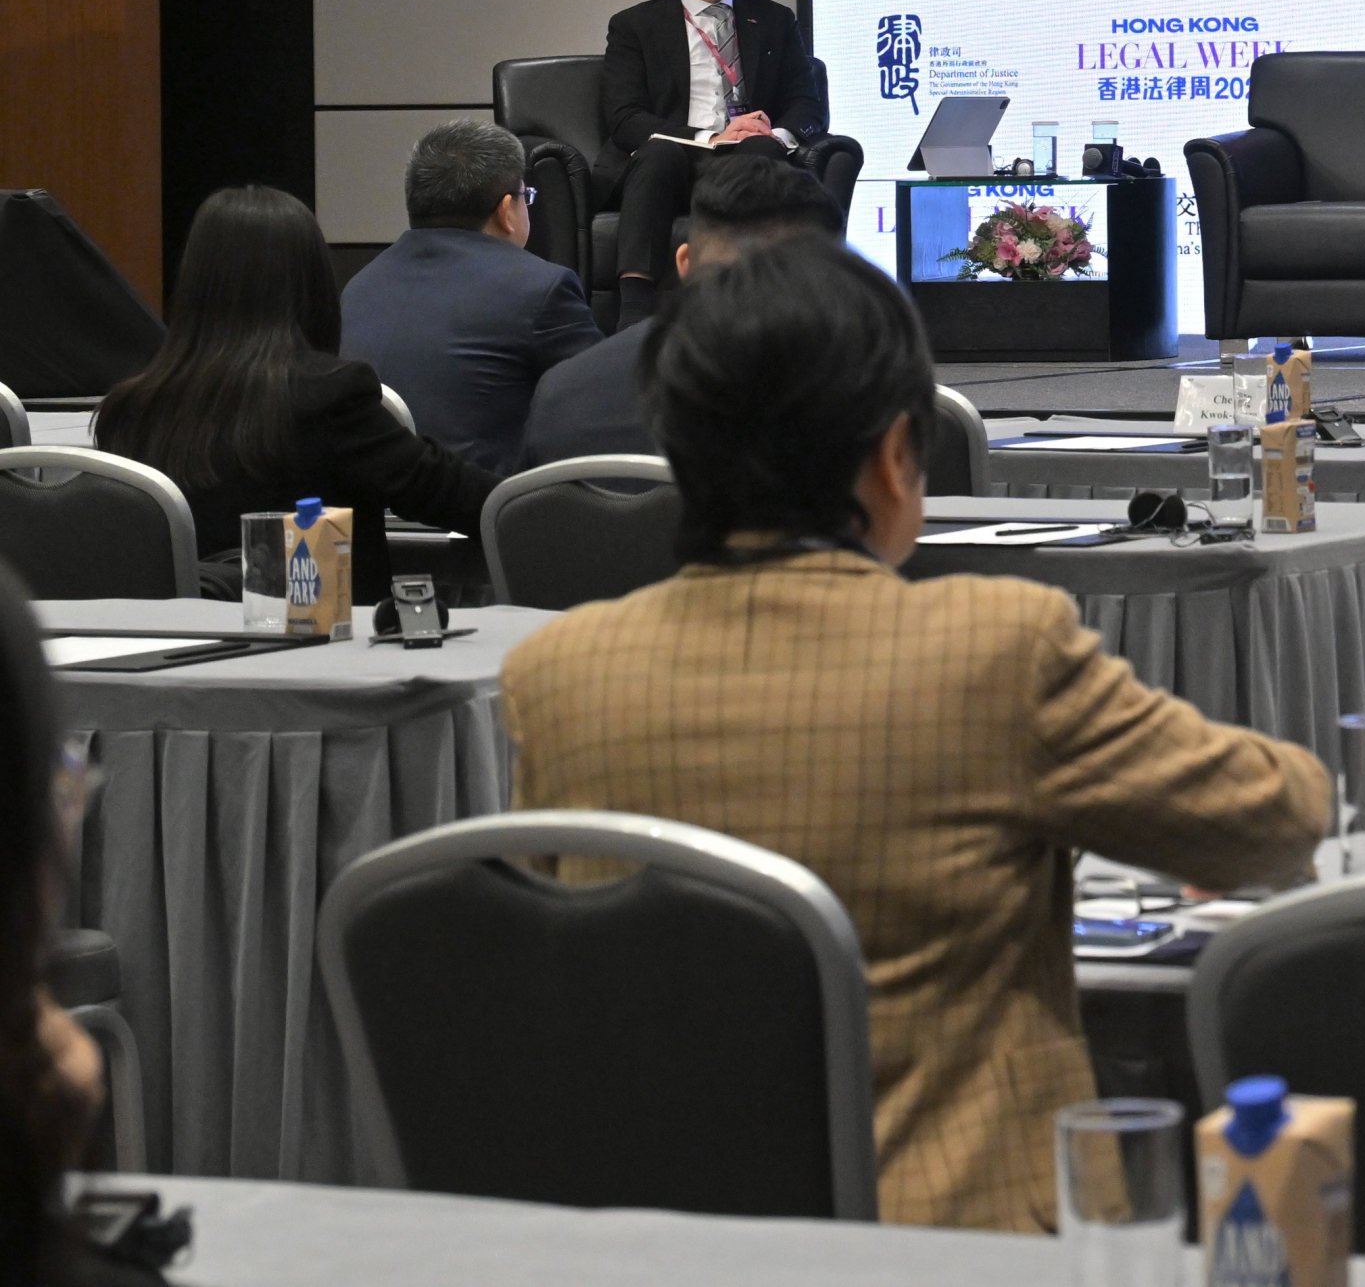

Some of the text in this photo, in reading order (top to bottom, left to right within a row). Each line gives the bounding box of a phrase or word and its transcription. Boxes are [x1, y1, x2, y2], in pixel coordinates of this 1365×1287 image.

[1112, 17, 1259, 34] HONG KONG
[1078, 42, 1187, 70] LEGAL
[1098, 74, 1250, 101] 香港法律周20
[287, 557, 318, 581] LAND
[287, 581, 318, 605] PARK
